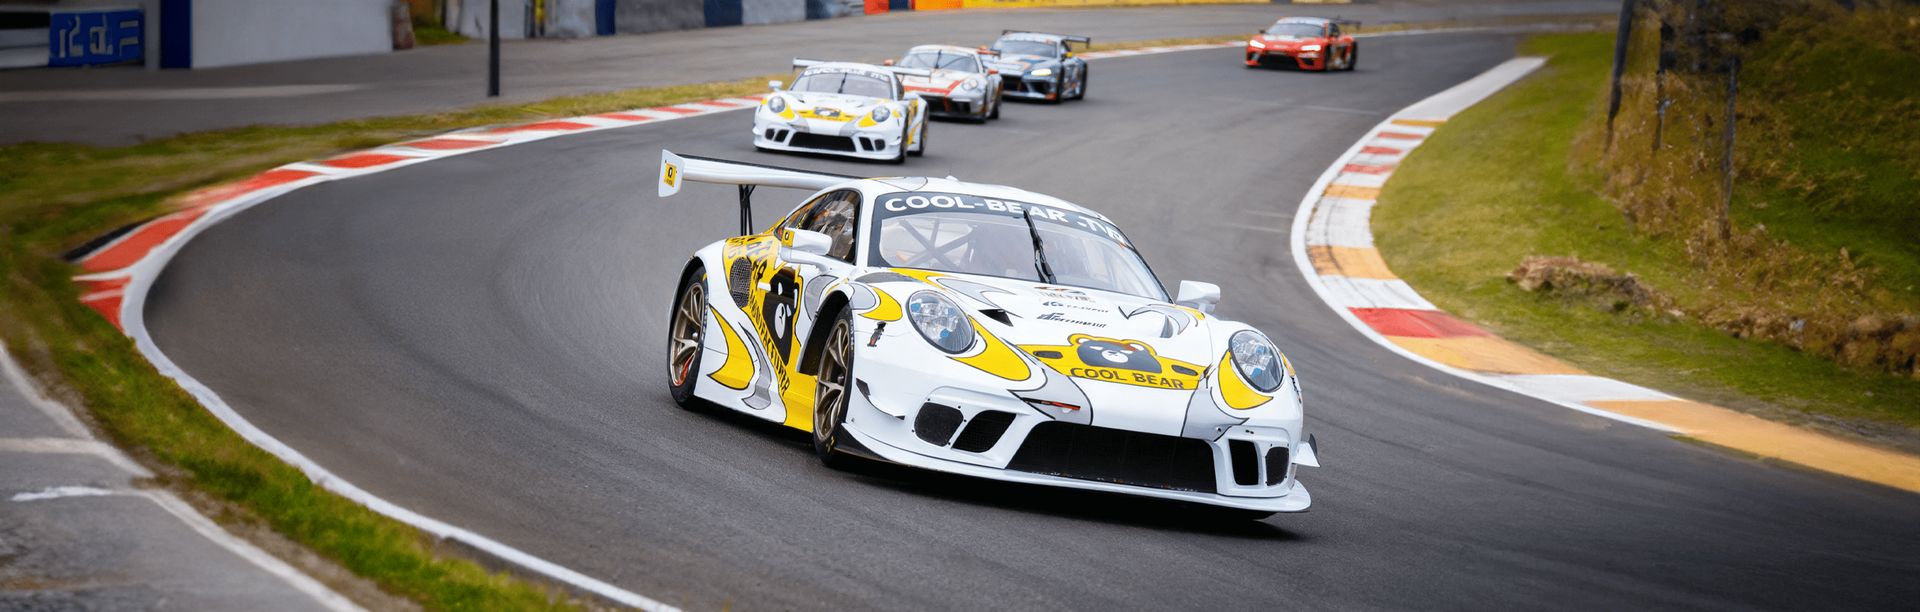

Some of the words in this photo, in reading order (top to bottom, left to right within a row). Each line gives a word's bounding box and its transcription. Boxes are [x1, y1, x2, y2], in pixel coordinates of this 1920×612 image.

[884, 195, 1069, 222] COOL-BEAR
[1070, 367, 1127, 381] COOL
[1132, 372, 1184, 389] BEAR
